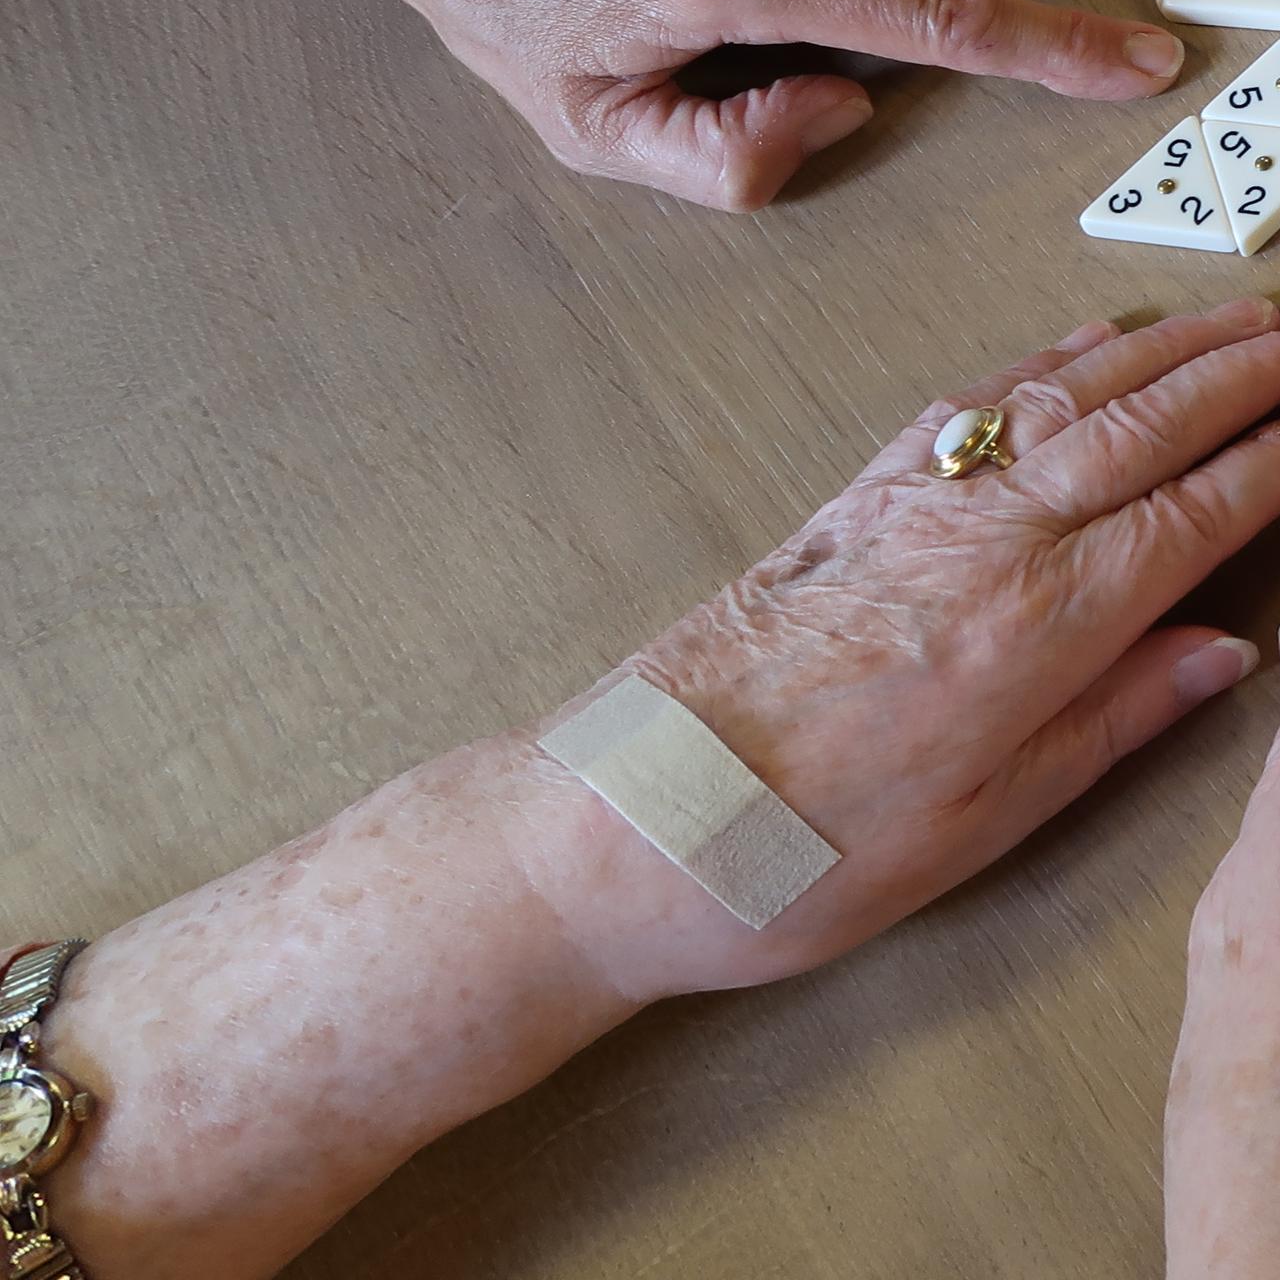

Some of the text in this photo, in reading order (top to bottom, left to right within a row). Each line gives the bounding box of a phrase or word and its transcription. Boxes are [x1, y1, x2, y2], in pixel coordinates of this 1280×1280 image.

[1228, 86, 1263, 109] 5
[1163, 138, 1192, 168] 5
[1219, 130, 1252, 159] 5
[1108, 189, 1143, 214] 3
[1180, 196, 1214, 226] 2
[1237, 185, 1267, 216] 2
